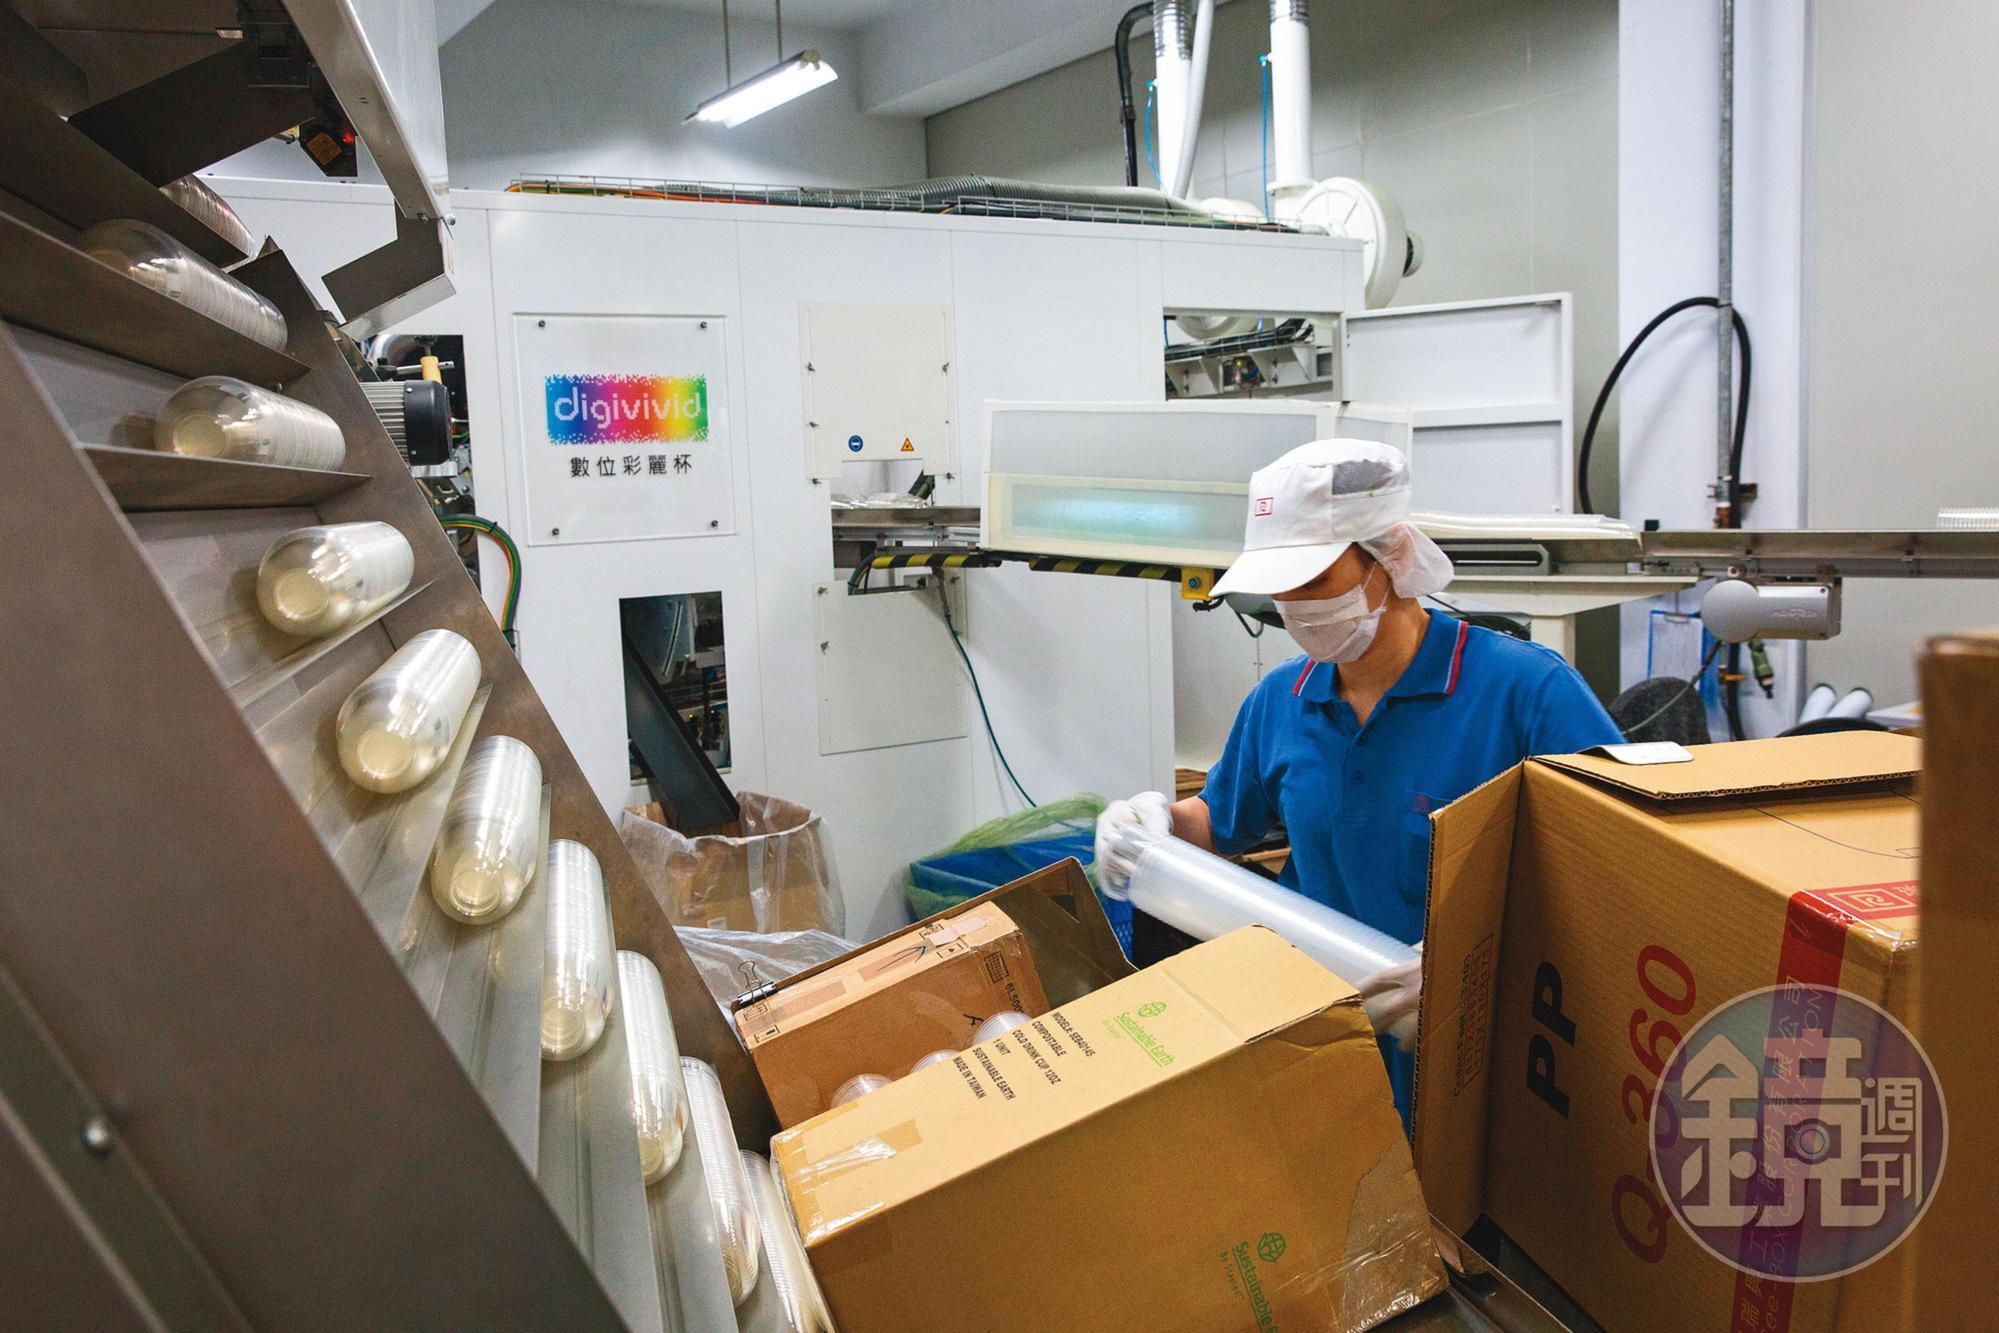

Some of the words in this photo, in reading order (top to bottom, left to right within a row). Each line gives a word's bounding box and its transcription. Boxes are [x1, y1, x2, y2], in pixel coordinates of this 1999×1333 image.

[553, 386, 702, 429] digivivid
[570, 453, 693, 479] 數位彩麗杯
[995, 1042, 1012, 1057] UNIT
[1011, 1029, 1028, 1045] COLD
[1022, 1042, 1039, 1061] DRINK
[1035, 1058, 1050, 1071] CUP
[1031, 1020, 1067, 1057] COMPOSTABLE
[1151, 1044, 1176, 1066] Earth
[1526, 961, 1577, 1119] PP
[952, 1056, 969, 1072] MADE
[966, 1074, 988, 1100] TAIWAN
[972, 1047, 1003, 1083] SUSTAINABLE
[996, 1077, 1016, 1101] EARTH
[1611, 944, 1697, 1265] Q-360
[1235, 1241, 1272, 1327] Sustainable
